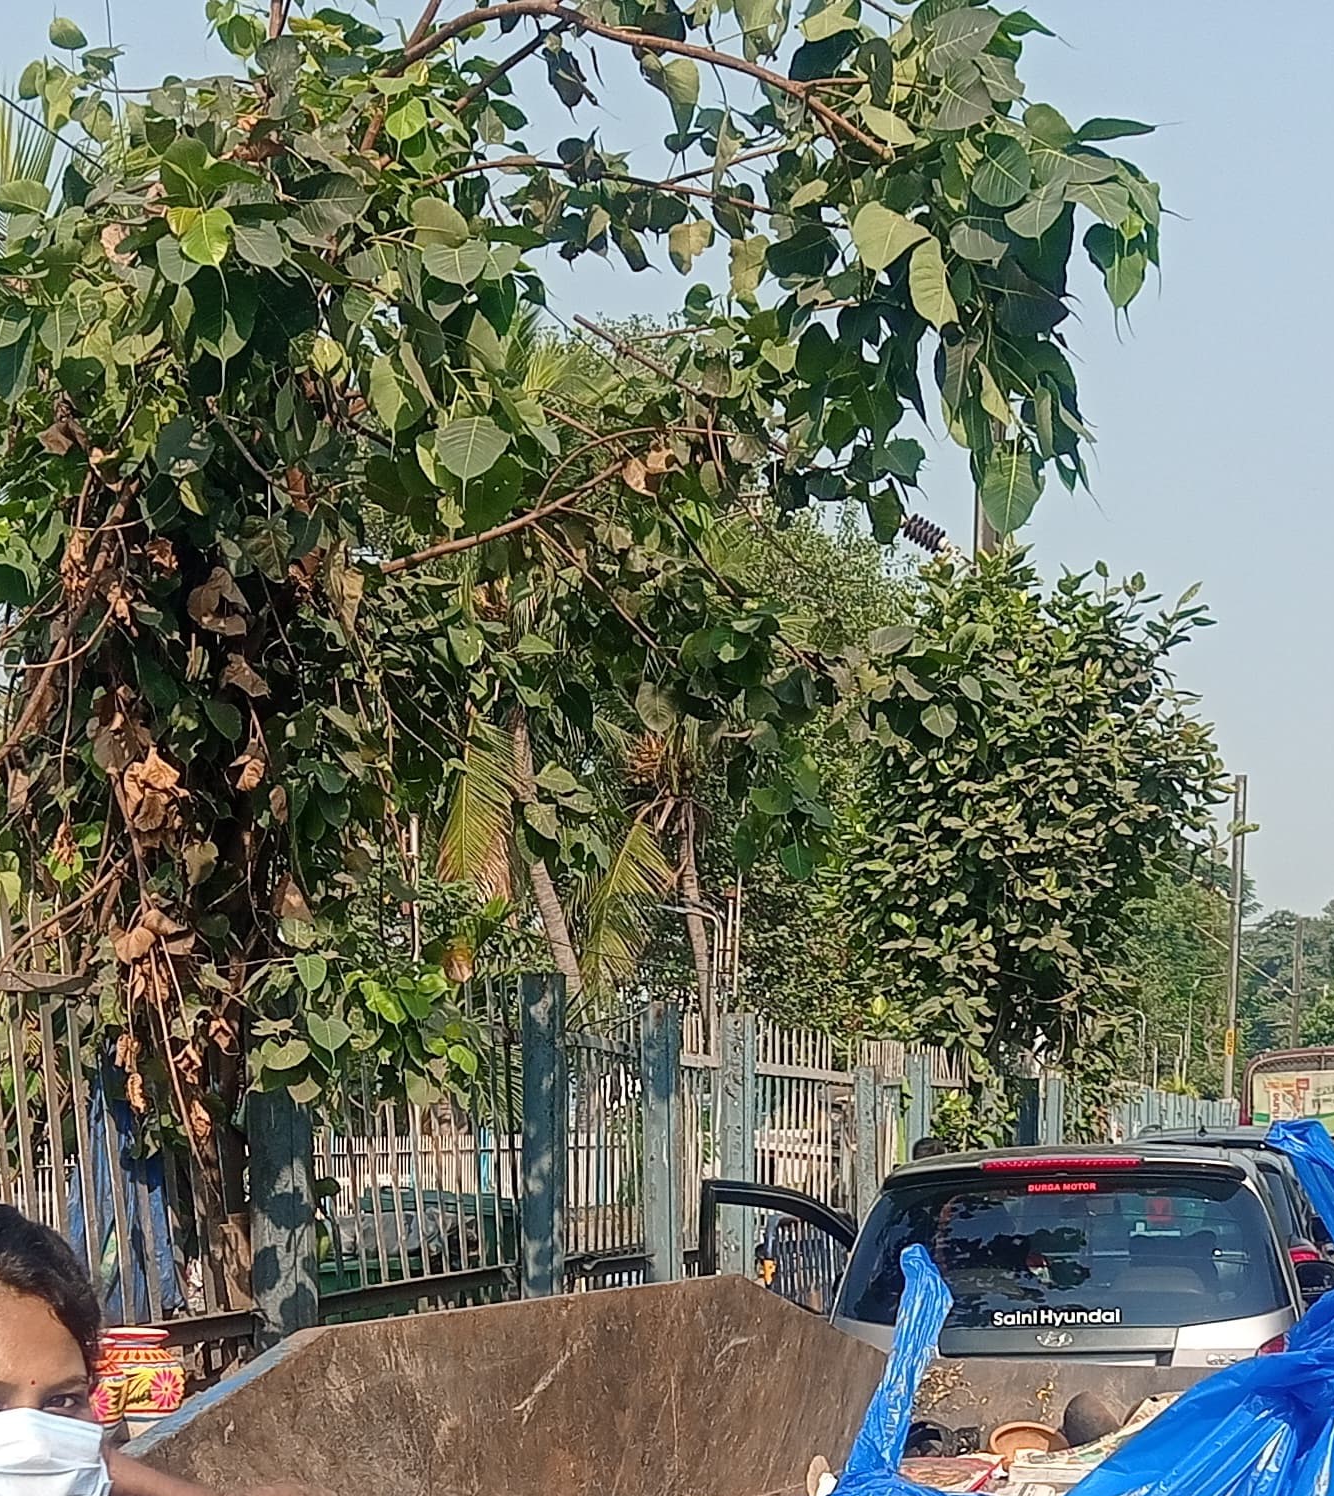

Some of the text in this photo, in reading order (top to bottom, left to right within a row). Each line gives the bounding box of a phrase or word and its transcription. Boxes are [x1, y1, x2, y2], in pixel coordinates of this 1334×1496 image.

[1027, 1182, 1096, 1192] DURGA MOTOR
[993, 1308, 1121, 1327] Saini Hyundai
